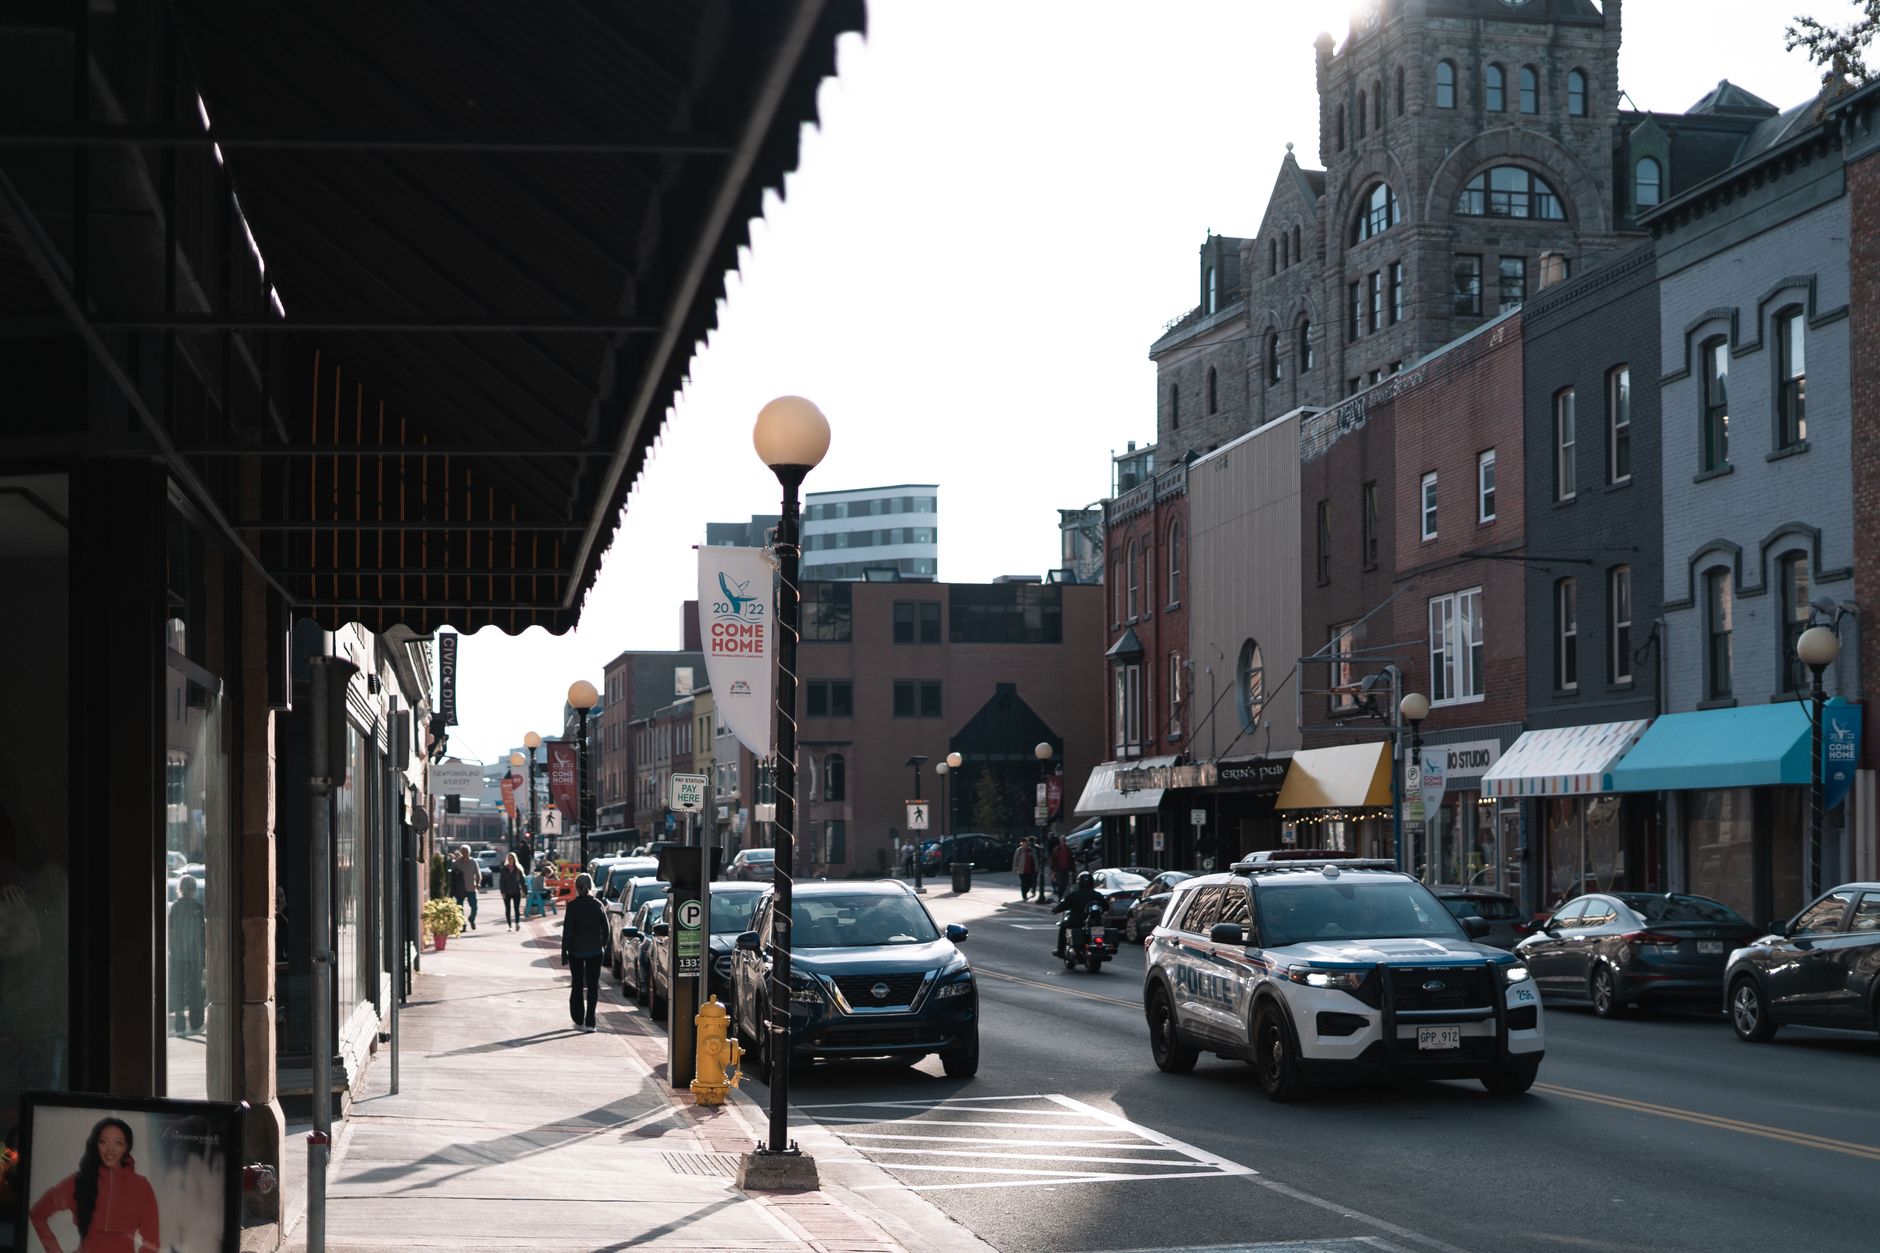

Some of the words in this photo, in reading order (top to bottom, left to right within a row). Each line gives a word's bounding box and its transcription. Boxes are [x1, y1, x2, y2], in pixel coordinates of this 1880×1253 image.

[713, 602, 729, 614] 20
[748, 603, 764, 615] 22
[711, 622, 764, 638] COME
[711, 638, 764, 653] HOME
[443, 637, 456, 676] CIVIC
[1458, 749, 1490, 768] STUDIO
[681, 784, 698, 793] PAY
[677, 793, 701, 803] HERE
[687, 906, 700, 924] P
[1176, 962, 1235, 1004] POLICE
[1420, 1031, 1437, 1043] GPP
[1441, 1031, 1458, 1042] 912
